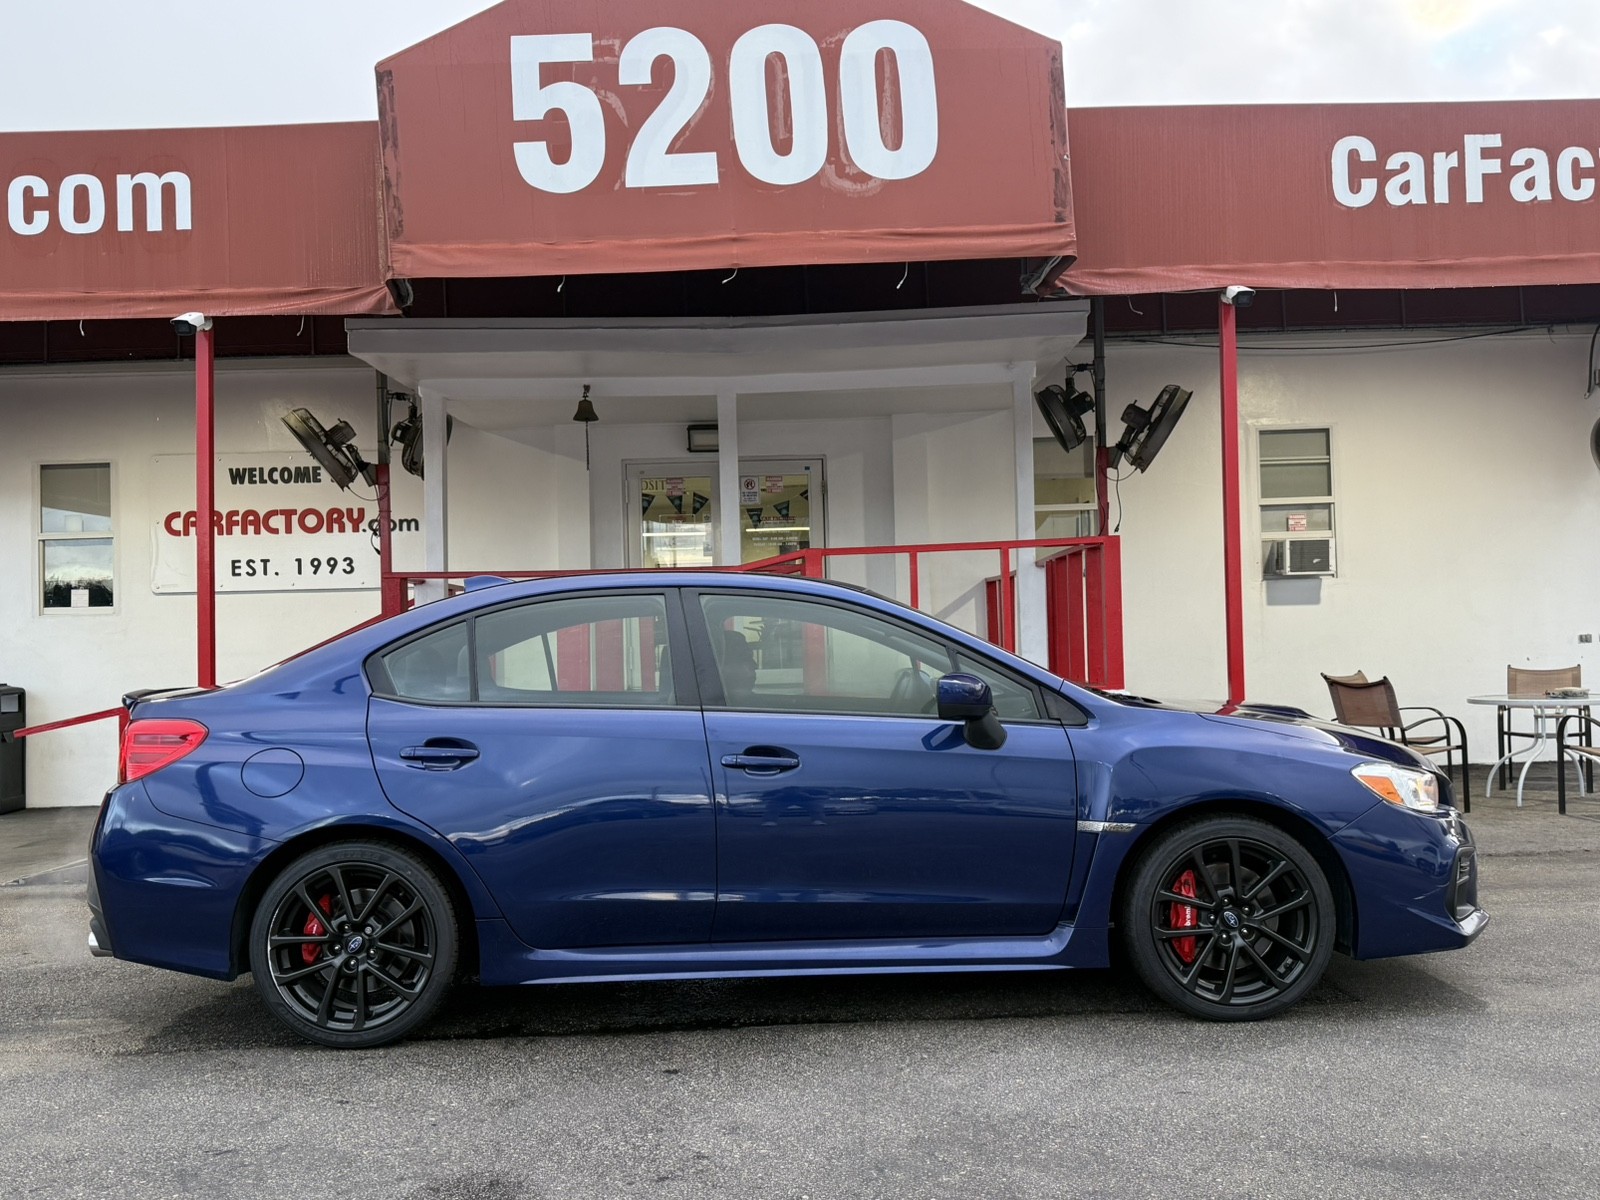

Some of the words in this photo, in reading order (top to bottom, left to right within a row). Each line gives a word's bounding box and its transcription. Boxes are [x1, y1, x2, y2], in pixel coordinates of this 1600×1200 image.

[509, 19, 938, 193] 5200
[1331, 133, 1600, 208] CarFac
[7, 171, 192, 236] com
[228, 466, 321, 485] WELCOME
[231, 559, 280, 577] EST.
[295, 556, 355, 576] 1993
